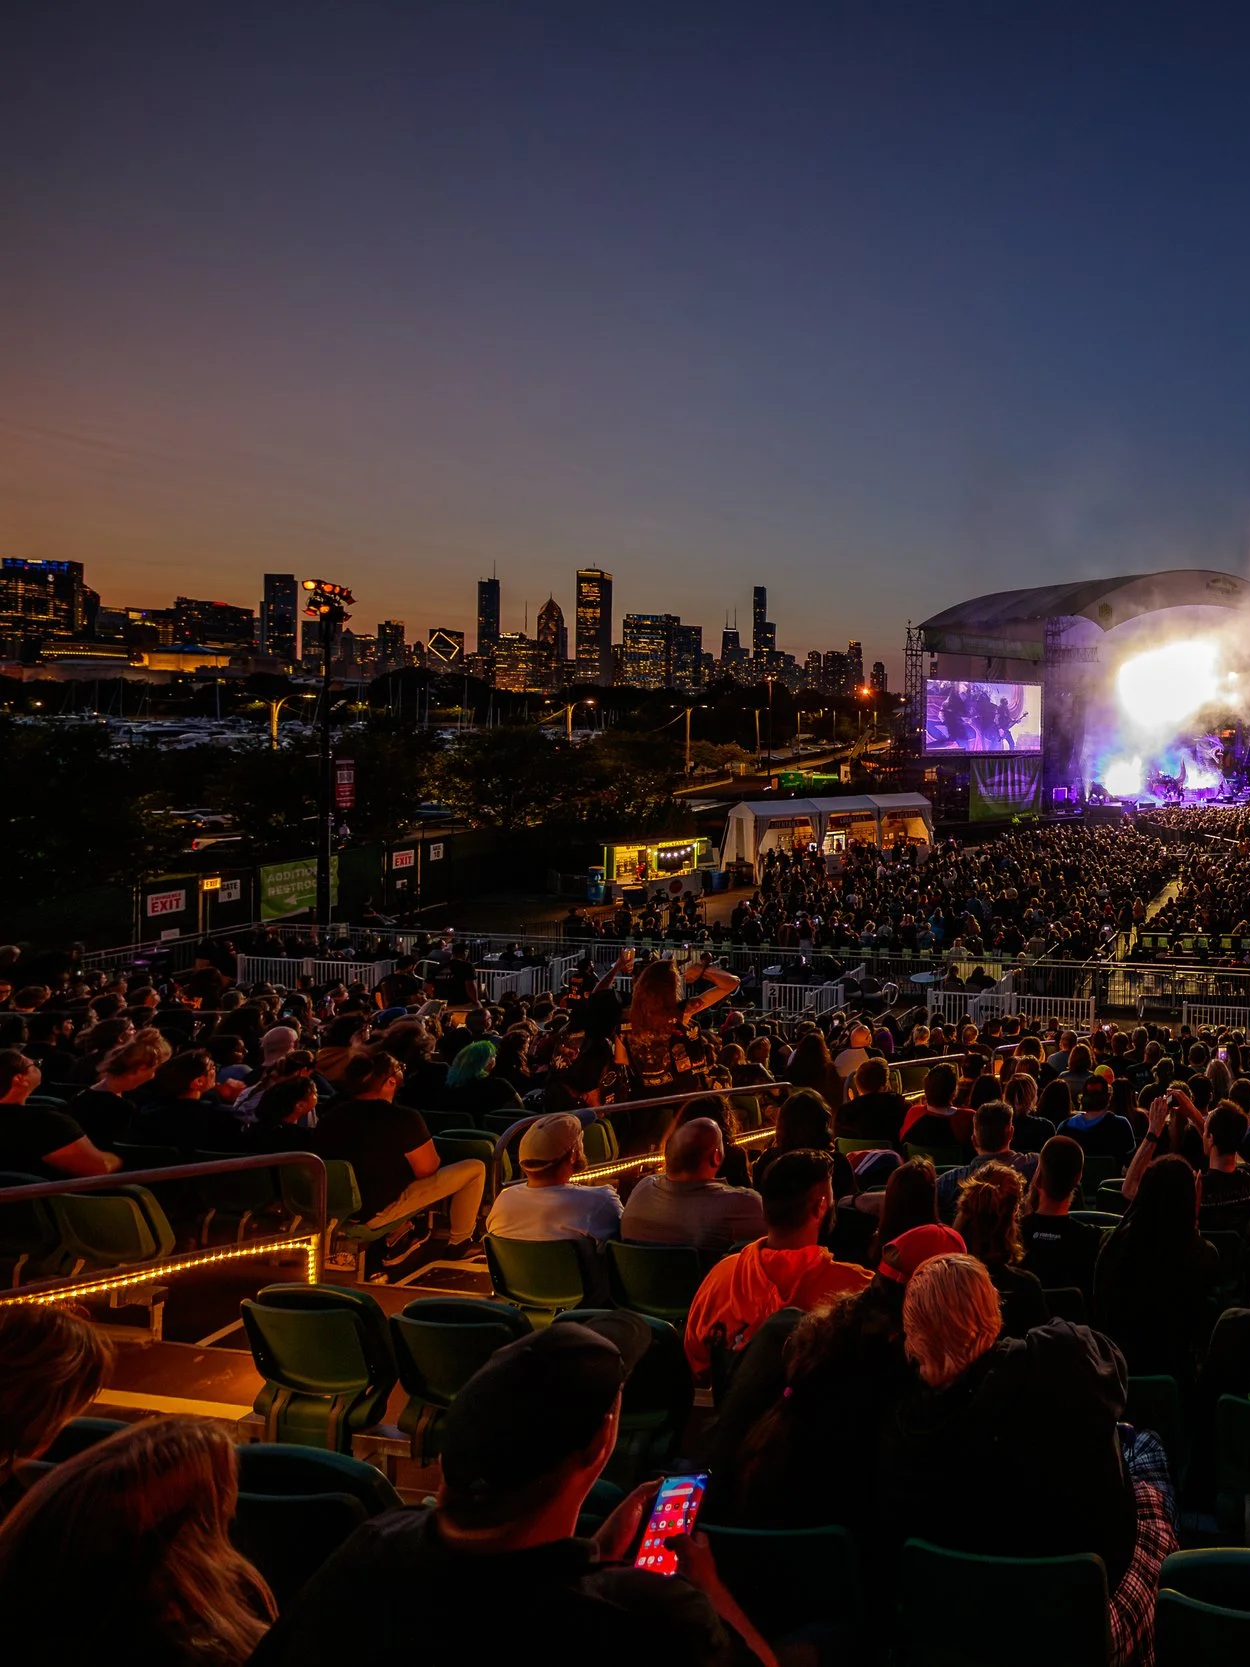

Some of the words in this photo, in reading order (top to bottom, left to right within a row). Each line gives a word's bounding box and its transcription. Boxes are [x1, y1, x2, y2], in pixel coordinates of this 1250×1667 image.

[394, 855, 413, 868] EXIT
[265, 866, 318, 882] ADDITIO
[267, 879, 318, 897] RESTROO
[151, 898, 181, 914] EXIT
[769, 987, 776, 996] 2
